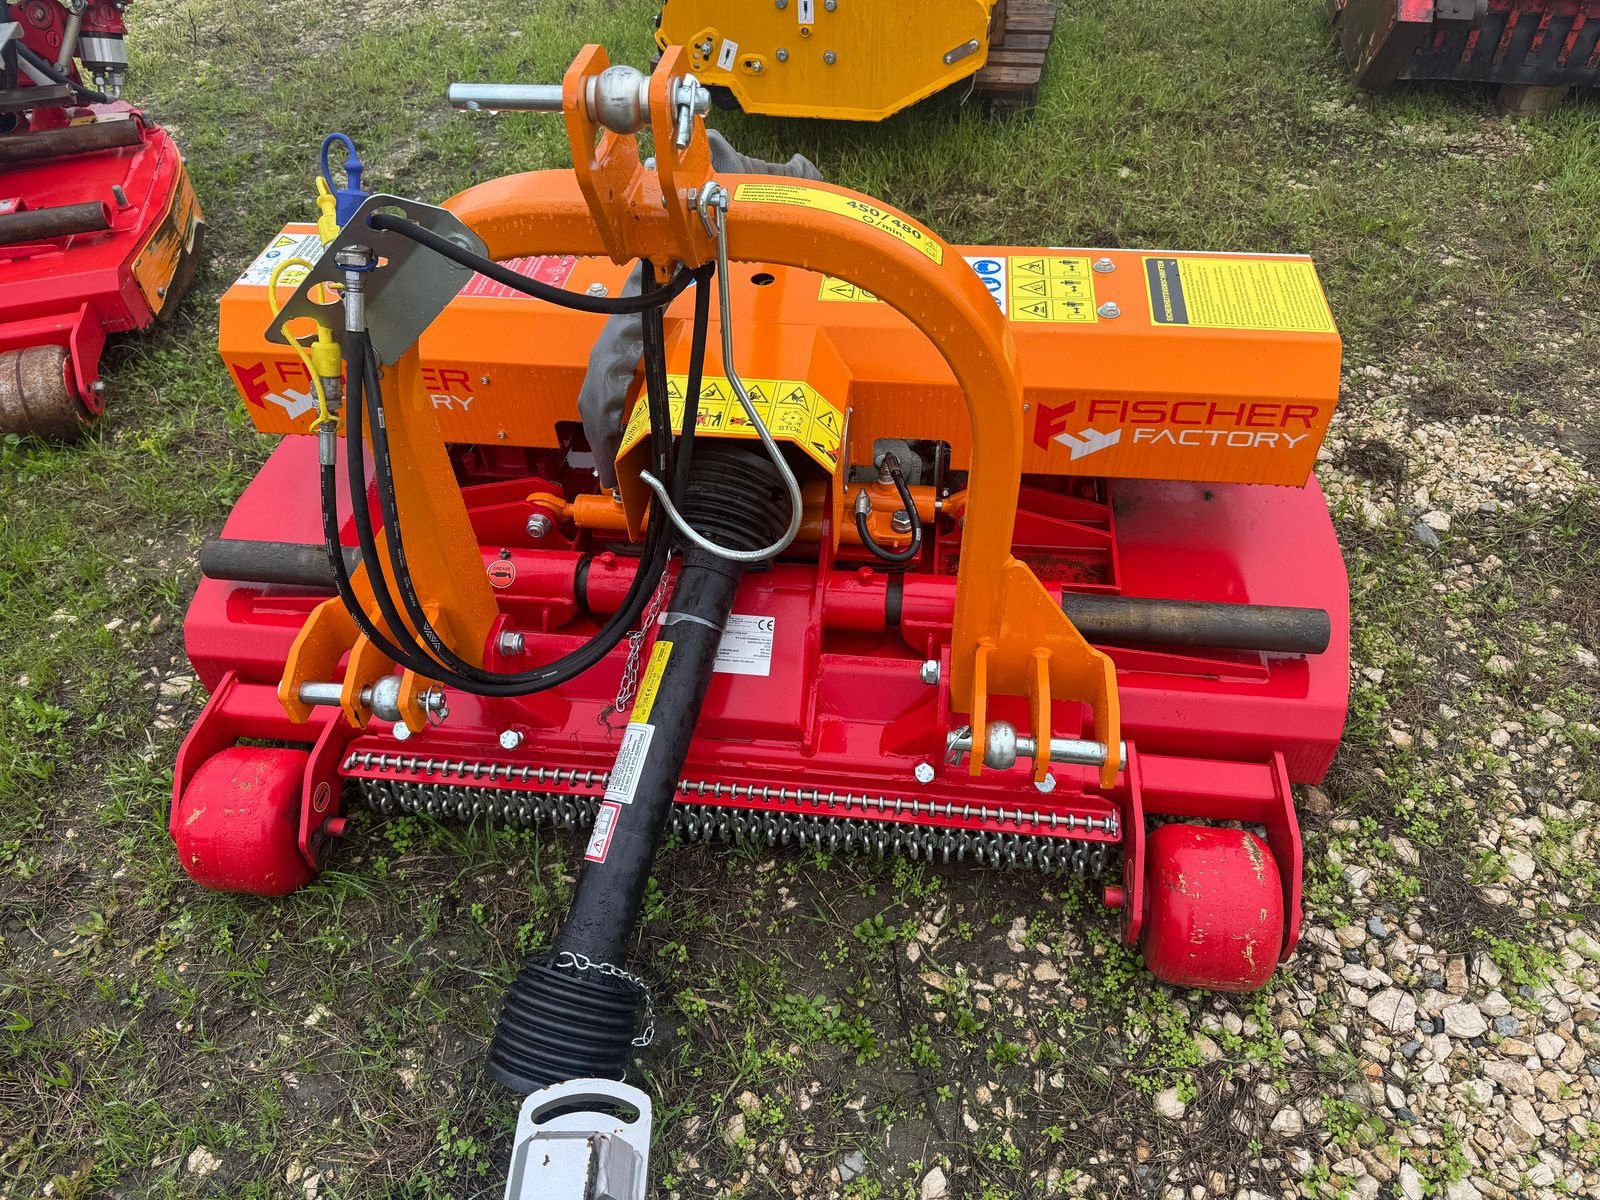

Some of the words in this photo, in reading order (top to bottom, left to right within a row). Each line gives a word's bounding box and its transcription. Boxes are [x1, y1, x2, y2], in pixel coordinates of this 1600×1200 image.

[1088, 400, 1318, 428] FISCHER
[778, 425, 801, 434] STOP
[1133, 428, 1309, 449] FACTORY
